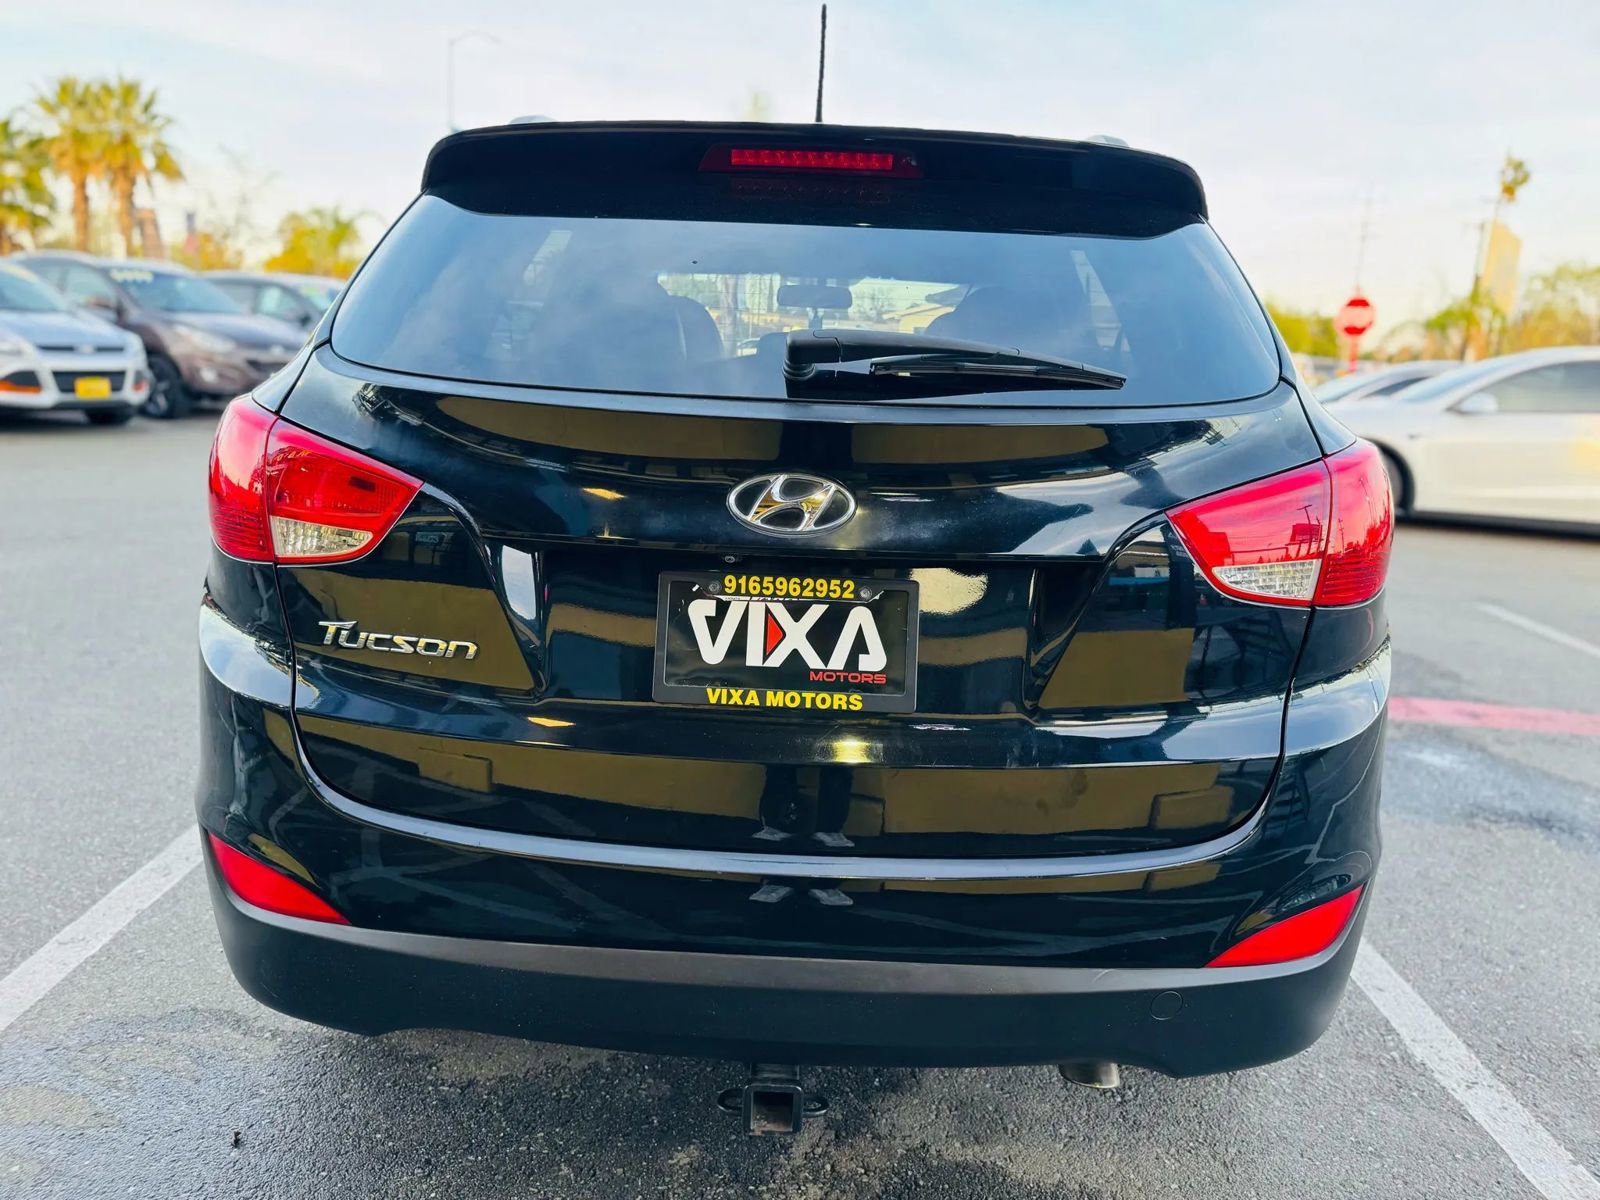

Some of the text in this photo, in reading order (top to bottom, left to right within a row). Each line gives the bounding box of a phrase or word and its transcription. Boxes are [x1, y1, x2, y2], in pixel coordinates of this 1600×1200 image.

[724, 575, 855, 599] 9165962952
[318, 620, 478, 660] Tucson
[687, 599, 888, 672] VIXA
[809, 671, 887, 684] MOTORS
[706, 687, 863, 711] VIXA MOTORS
